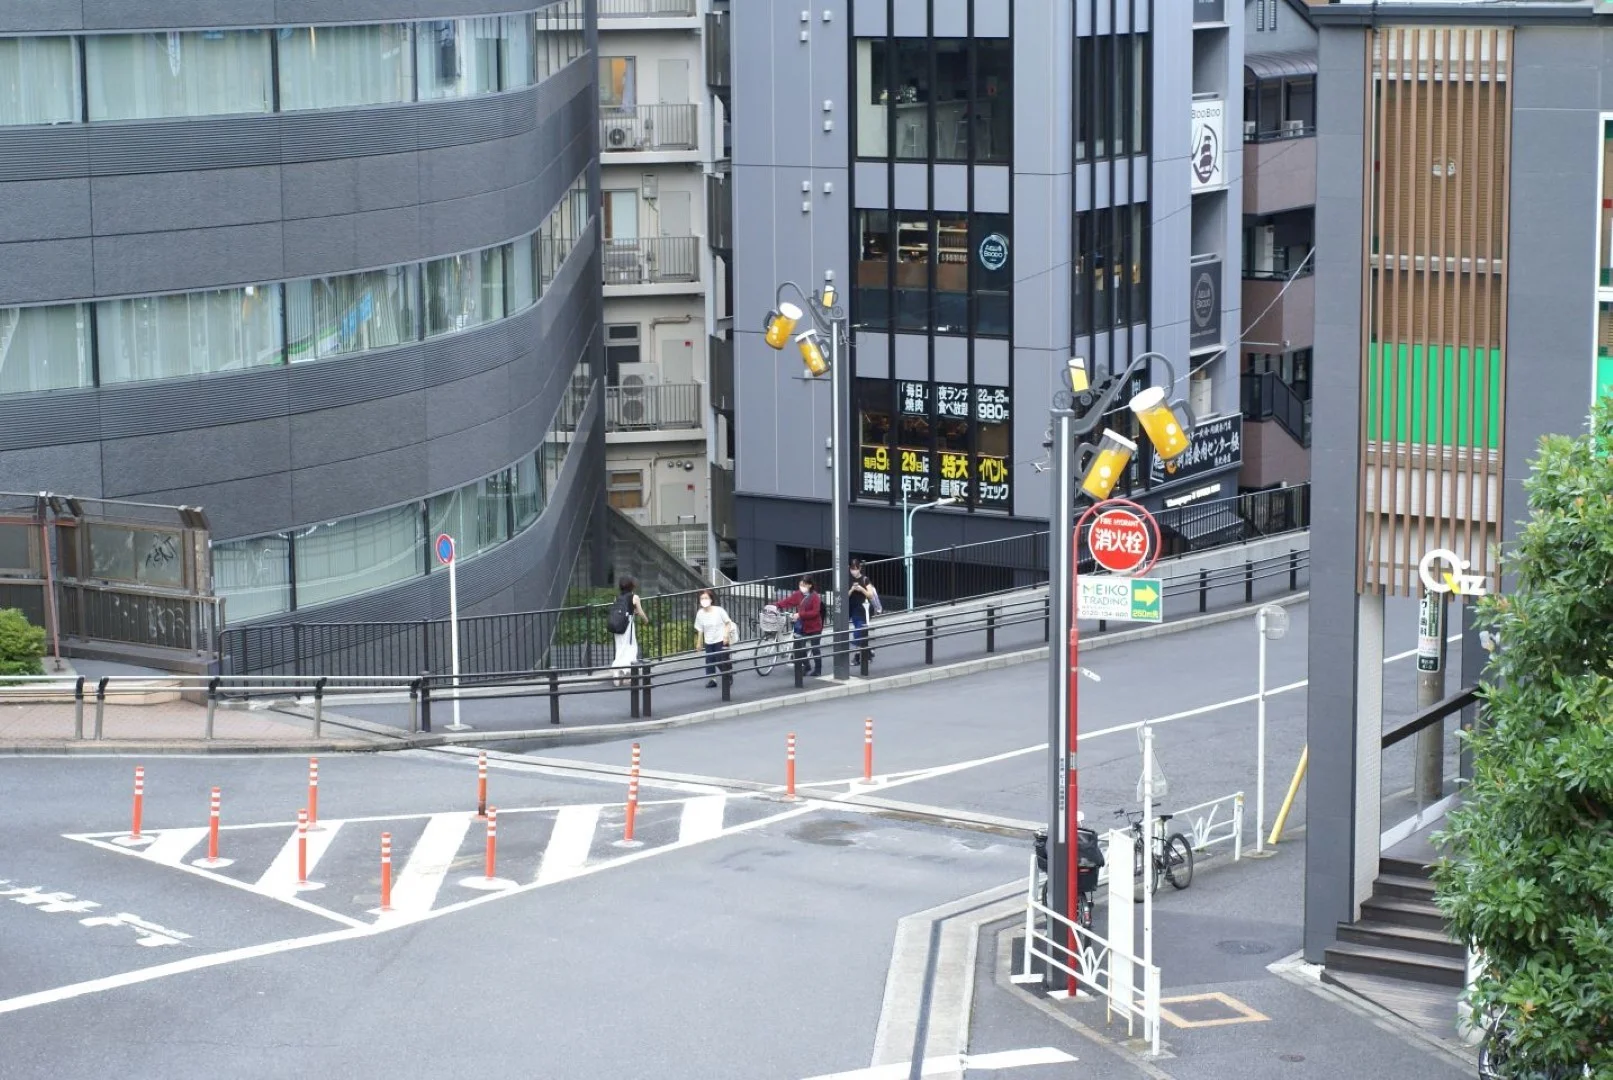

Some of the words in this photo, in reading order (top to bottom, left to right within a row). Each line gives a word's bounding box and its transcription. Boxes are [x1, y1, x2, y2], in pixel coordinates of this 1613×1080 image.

[938, 385, 968, 401] 夜ランチ
[904, 398, 923, 413] 焼肉
[978, 403, 1009, 420] 980円
[941, 454, 968, 479] 特大
[979, 458, 1009, 483] イベント
[979, 482, 1009, 499] チェック
[1100, 517, 1112, 525] FIRE
[1113, 518, 1139, 528] HYDRANT
[1094, 527, 1145, 554] 消火栓
[1082, 584, 1129, 596] MEIKO
[1082, 595, 1129, 606] TRADING
